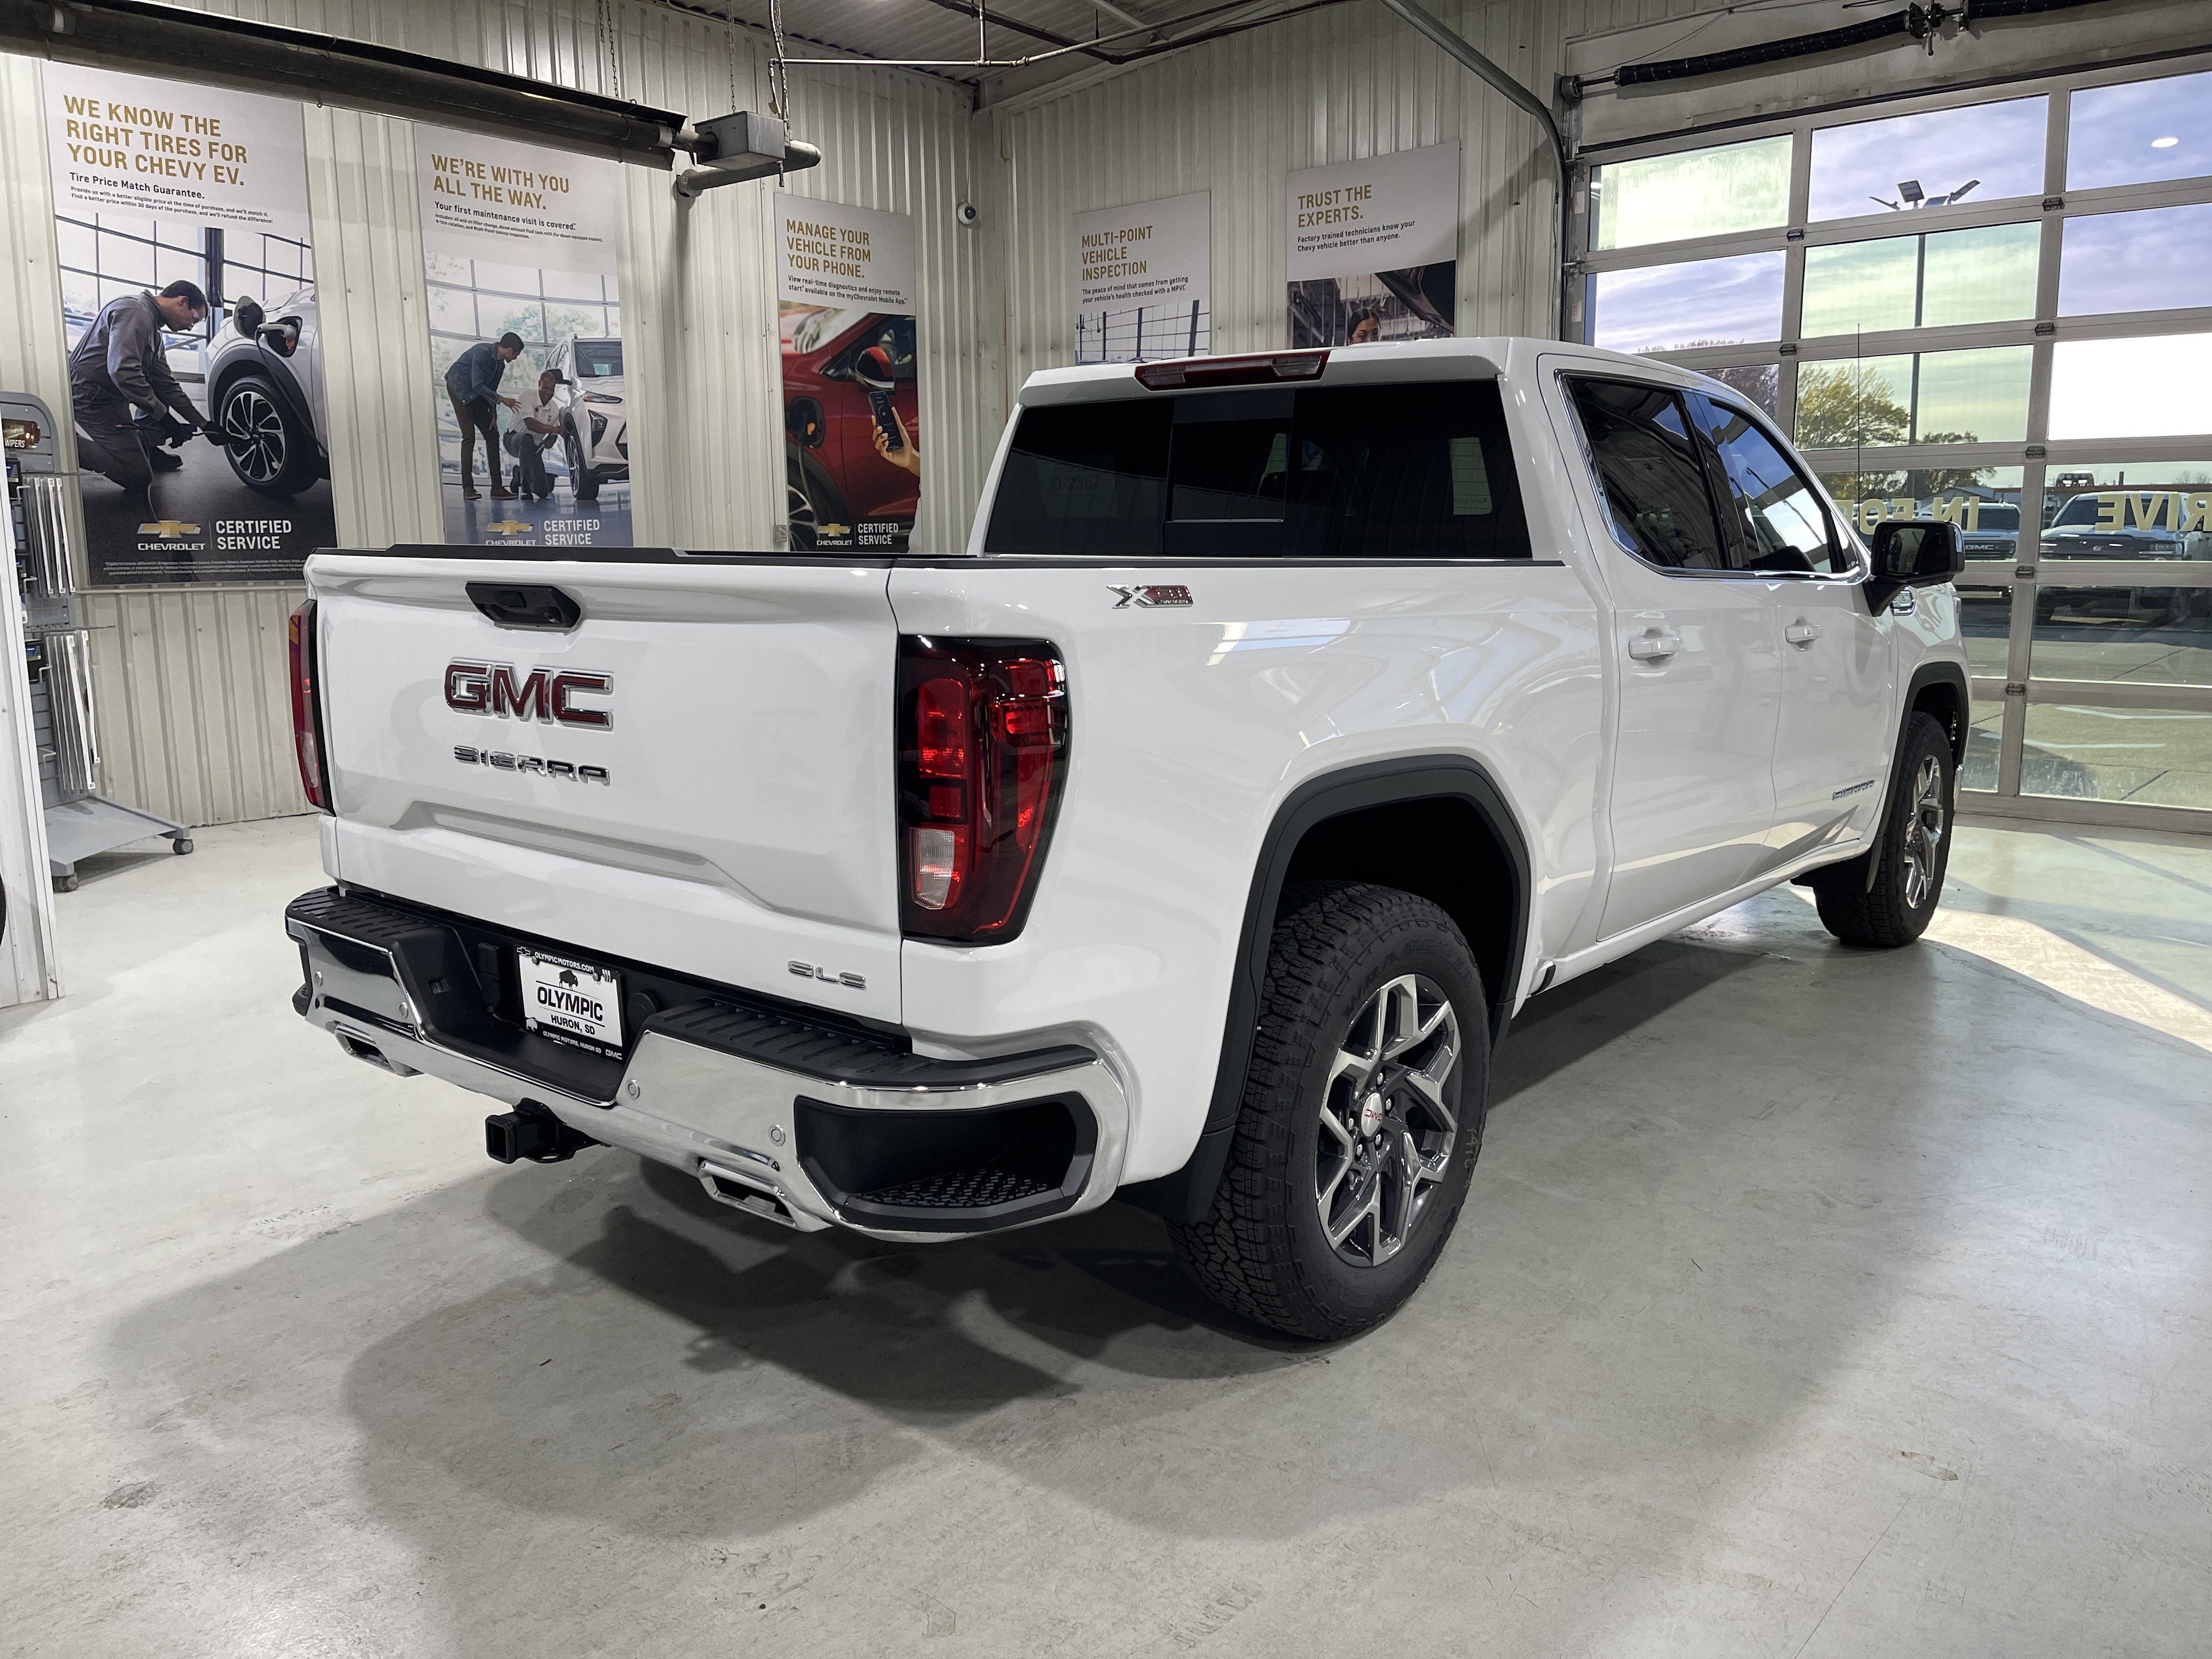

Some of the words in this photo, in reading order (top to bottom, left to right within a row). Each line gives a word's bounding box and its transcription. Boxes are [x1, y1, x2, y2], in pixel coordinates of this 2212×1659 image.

[63, 94, 100, 119] WE
[108, 103, 173, 129] KNOW
[180, 114, 221, 137] THE
[66, 119, 133, 146] RIGHT
[139, 131, 201, 156] TIRES
[208, 141, 249, 163] FOR
[67, 143, 127, 170] YOUR
[135, 154, 206, 180] CHEVY
[213, 163, 244, 185] EV.
[431, 153, 486, 178] WE'RE
[490, 165, 533, 187] WITH
[538, 173, 568, 193] YOU
[69, 172, 89, 183] Tire
[92, 176, 118, 187] Price
[121, 180, 150, 192] Match
[153, 184, 204, 199] Guarantee.
[433, 176, 466, 196] ALL
[470, 182, 503, 203] THE
[507, 189, 546, 210] WAY.
[1297, 189, 1341, 210] TRUST
[1345, 184, 1372, 202] THE
[434, 200, 452, 211] Your
[454, 204, 471, 215] first
[473, 210, 520, 222] maintenance
[521, 216, 537, 225] visit
[1298, 206, 1363, 228] EXPERTS.
[786, 218, 836, 240] MANAGE
[839, 228, 870, 246] YOUR
[1081, 225, 1153, 248] MULTI-POINT
[1322, 230, 1343, 240] trained
[1345, 226, 1380, 236] technicians
[1400, 220, 1415, 229] your
[787, 235, 836, 257] VEHICLE
[840, 245, 871, 263] FROM
[1316, 241, 1338, 250] vehicle
[1376, 233, 1400, 241] anyone.
[787, 253, 819, 271] YOUR
[823, 259, 865, 278] PHONE.
[1081, 246, 1127, 264] VEHICLE
[1082, 260, 1146, 281] INSPECTION
[1169, 276, 1188, 285] getting
[788, 274, 800, 283] View
[802, 278, 827, 286] real-time
[828, 281, 857, 290] diagnostics
[805, 287, 827, 296] available
[846, 293, 877, 302] myChevrolet
[1093, 294, 1114, 302] vehicle's
[1132, 288, 1153, 297] checked
[5, 439, 25, 448] WIPERS
[215, 520, 292, 535] CERTIFIED
[544, 520, 600, 532] CERTIFIED
[857, 523, 898, 533] CERTIFIED
[137, 542, 205, 551] CHEVROLET
[217, 536, 280, 550] SERVICE
[545, 533, 591, 545] SERVICE
[858, 535, 893, 545] SERVICE
[444, 658, 613, 732] GMC
[454, 745, 611, 786] SIERRA
[534, 951, 595, 973] OLYMPICMOTORS.COM
[537, 986, 603, 1022] OLYMPIC
[551, 1014, 582, 1034] HURON,
[585, 1024, 595, 1035] SD
[543, 1030, 560, 1041] OLYMPIC
[561, 1036, 580, 1047] MOTORS,
[580, 1042, 595, 1051] HURON
[605, 1049, 623, 1059] GMC
